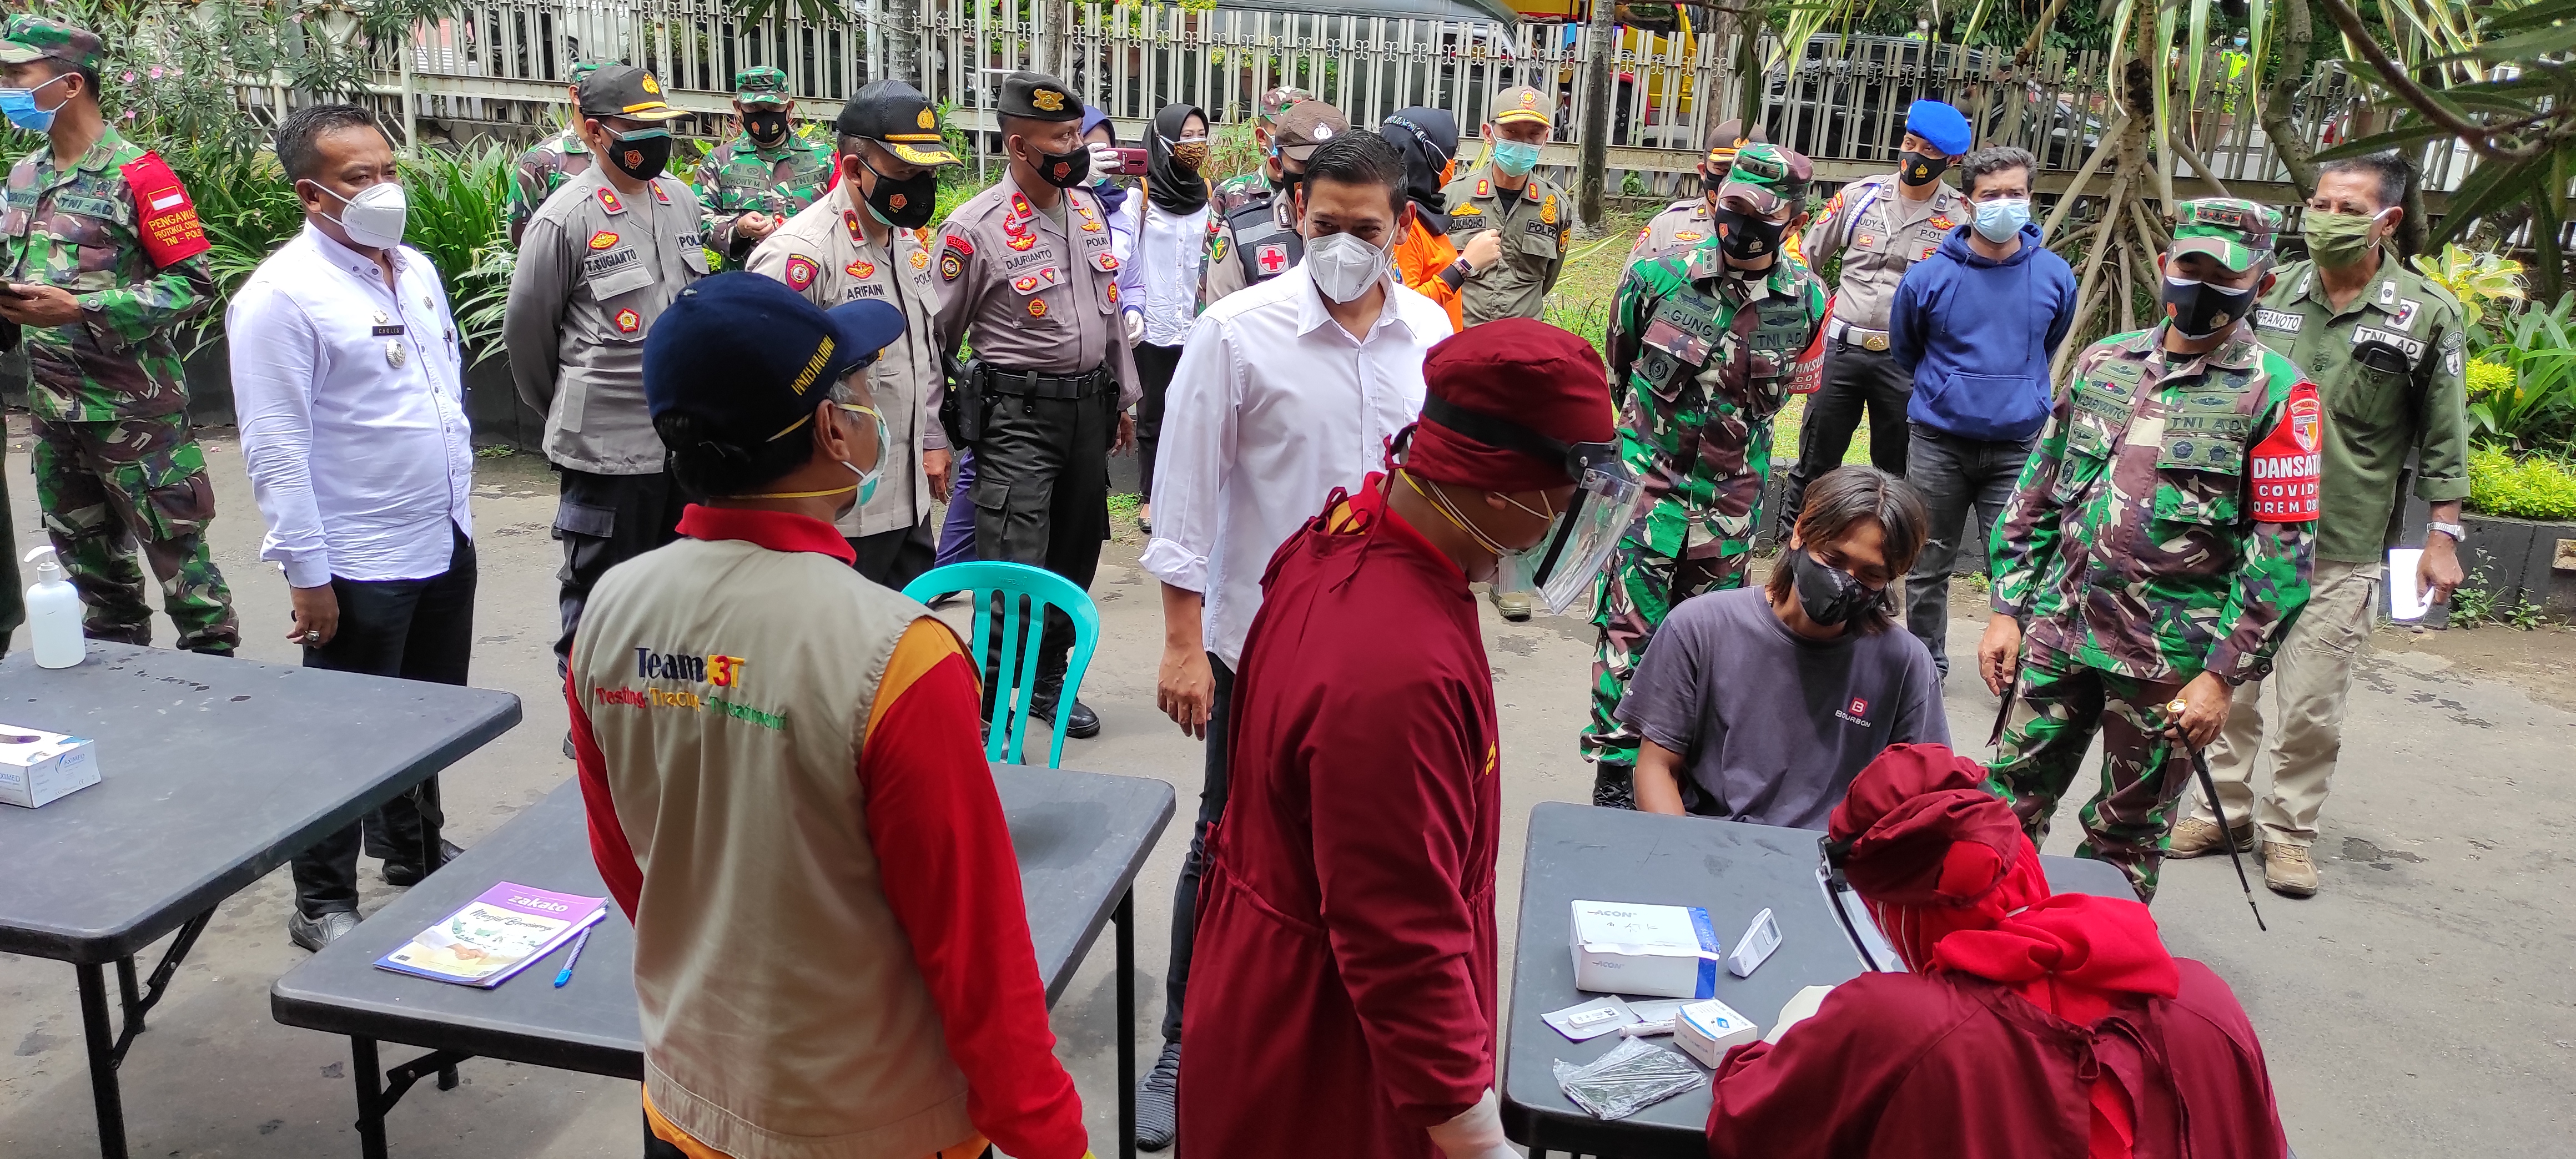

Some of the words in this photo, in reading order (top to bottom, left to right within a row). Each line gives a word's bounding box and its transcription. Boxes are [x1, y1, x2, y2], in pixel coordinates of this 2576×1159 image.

[792, 176, 809, 187] TNI
[148, 208, 196, 231] PENGAWAS
[1858, 218, 1879, 228] UDY
[1920, 229, 1945, 240] POL
[1086, 236, 1109, 249] POLRI
[585, 249, 637, 272] T.SUGIANTO
[1005, 249, 1052, 270] DJURIANTO
[1661, 306, 1714, 337] AGUNG
[2257, 311, 2299, 330] PRANOTO
[1756, 334, 1781, 347] TNI
[1785, 332, 1803, 345] AD
[2359, 329, 2388, 343] TNI
[2396, 338, 2418, 355] AD
[1796, 352, 1825, 374] ANSU
[1795, 370, 1821, 382] COV
[2171, 416, 2203, 429] TNI
[2211, 417, 2242, 431] AD
[635, 647, 704, 682] Team
[713, 654, 745, 688] 3T
[1835, 709, 1871, 728] BOURBON
[64, 753, 85, 766] AXIMED
[507, 894, 569, 913] zakato
[470, 908, 509, 923] Masjid
[1591, 910, 1632, 918] ACON
[1592, 960, 1622, 970] ACON
